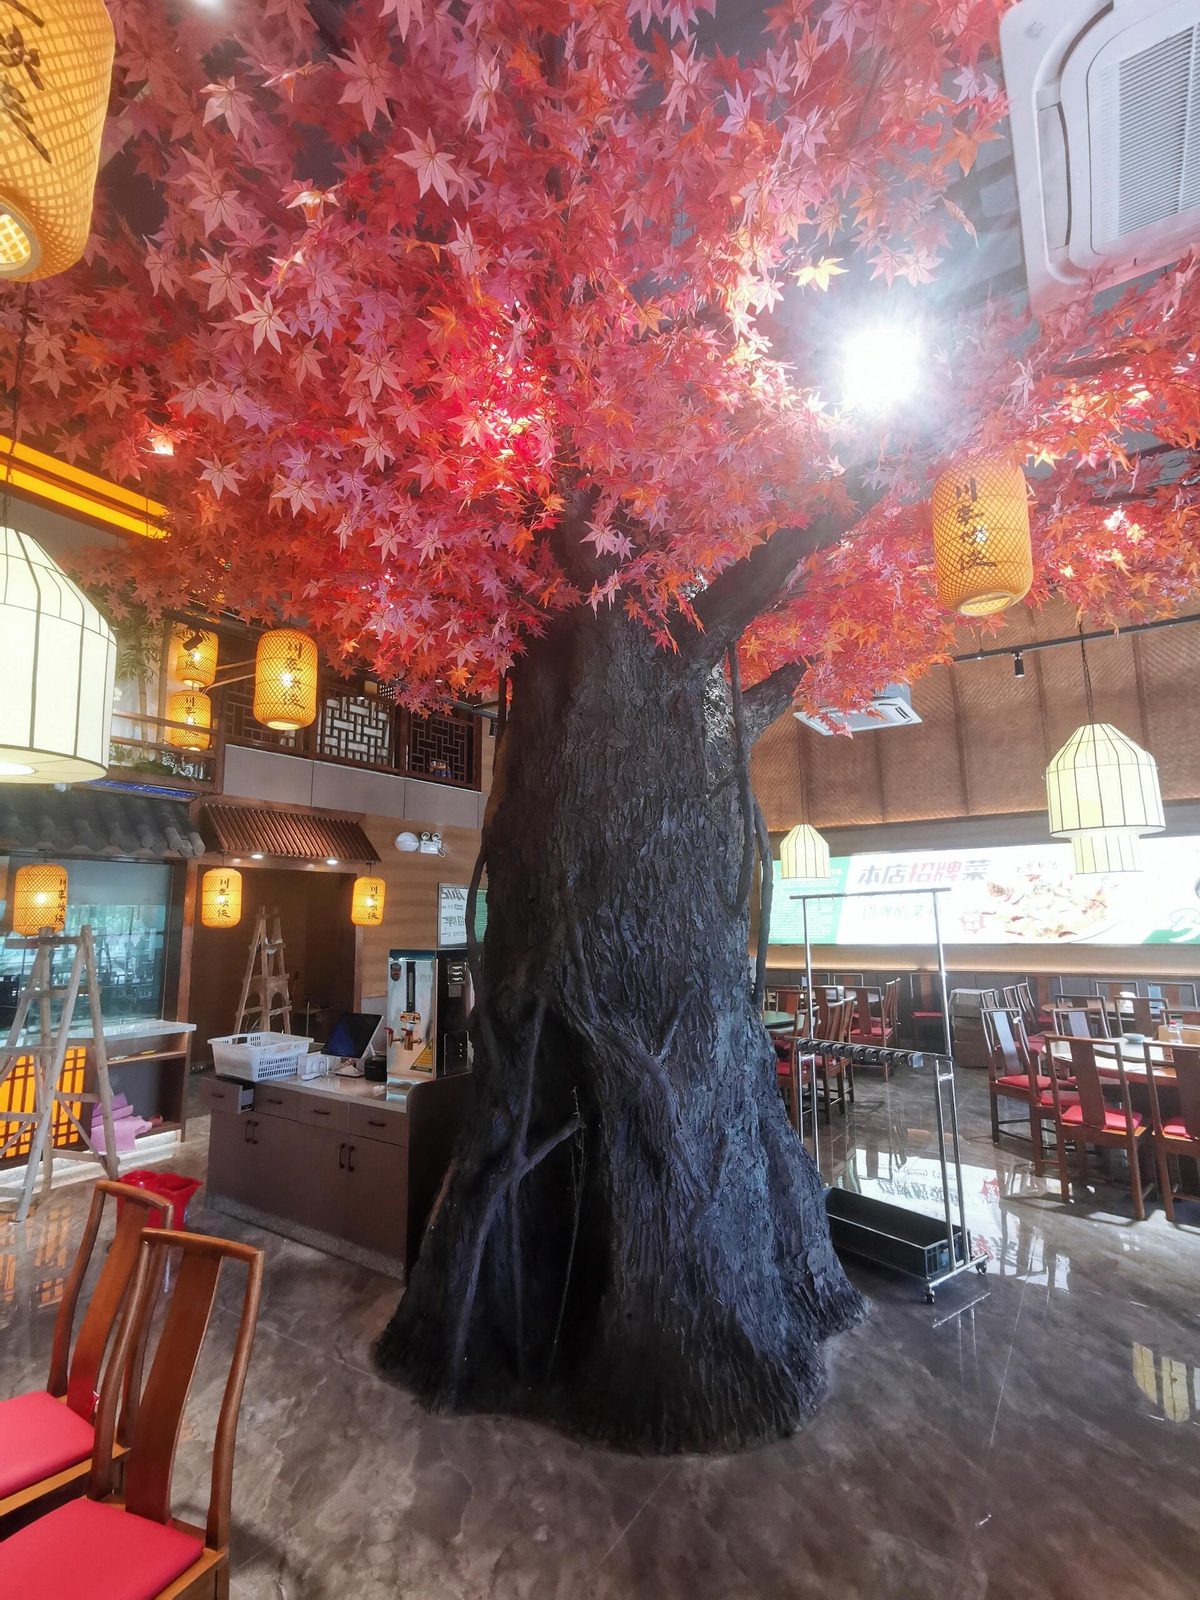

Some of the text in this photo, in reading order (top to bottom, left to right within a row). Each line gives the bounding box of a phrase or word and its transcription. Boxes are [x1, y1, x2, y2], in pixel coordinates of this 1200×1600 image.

[858, 859, 990, 885] 本店招牌菜
